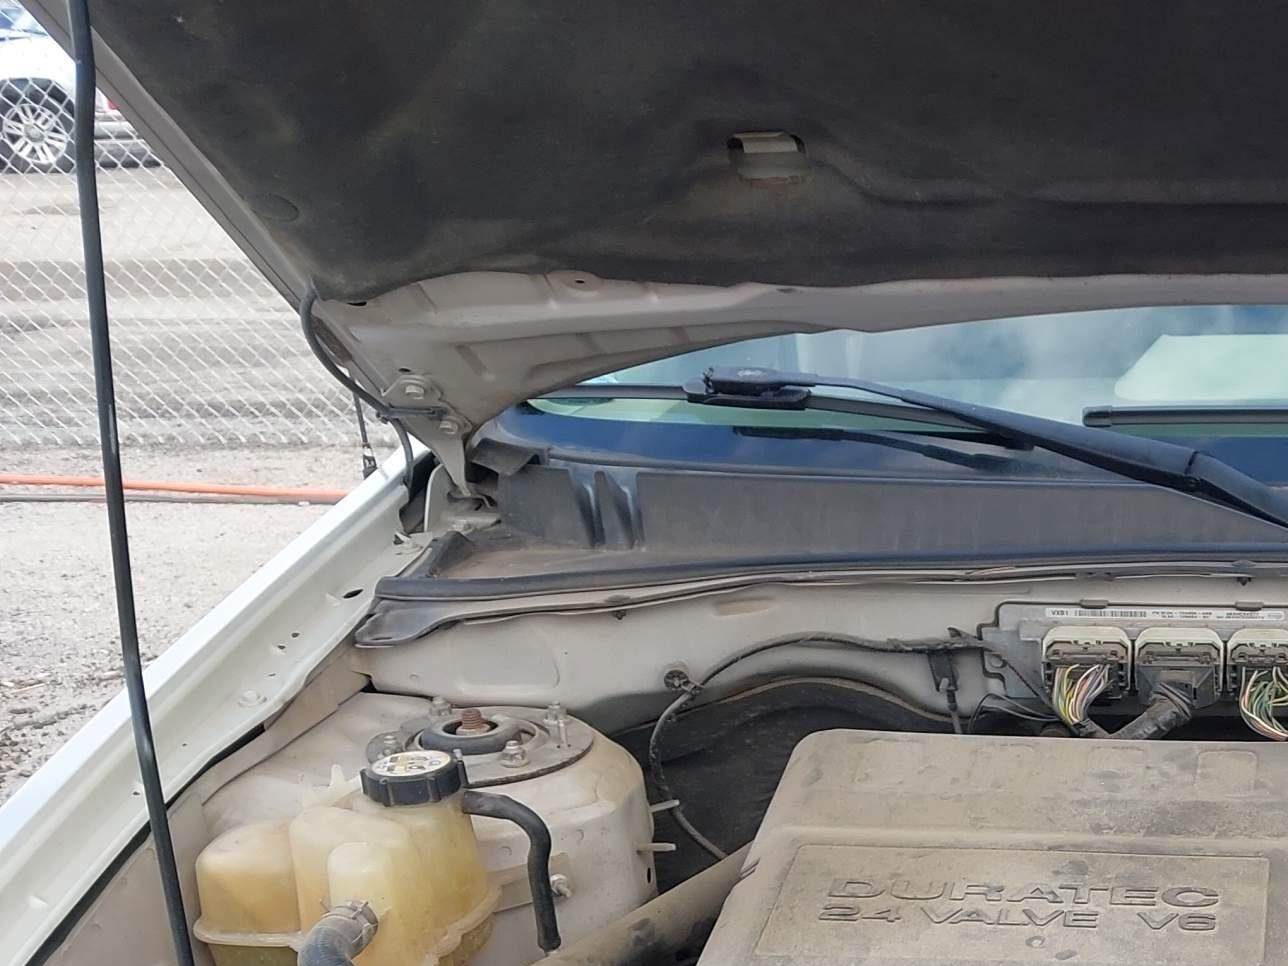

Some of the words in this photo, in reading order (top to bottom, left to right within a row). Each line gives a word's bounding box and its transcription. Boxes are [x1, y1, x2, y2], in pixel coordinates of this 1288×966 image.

[828, 878, 1220, 908] DURATEC
[818, 903, 901, 923] 24
[919, 905, 1100, 929] VALVE
[1136, 910, 1218, 932] V6
